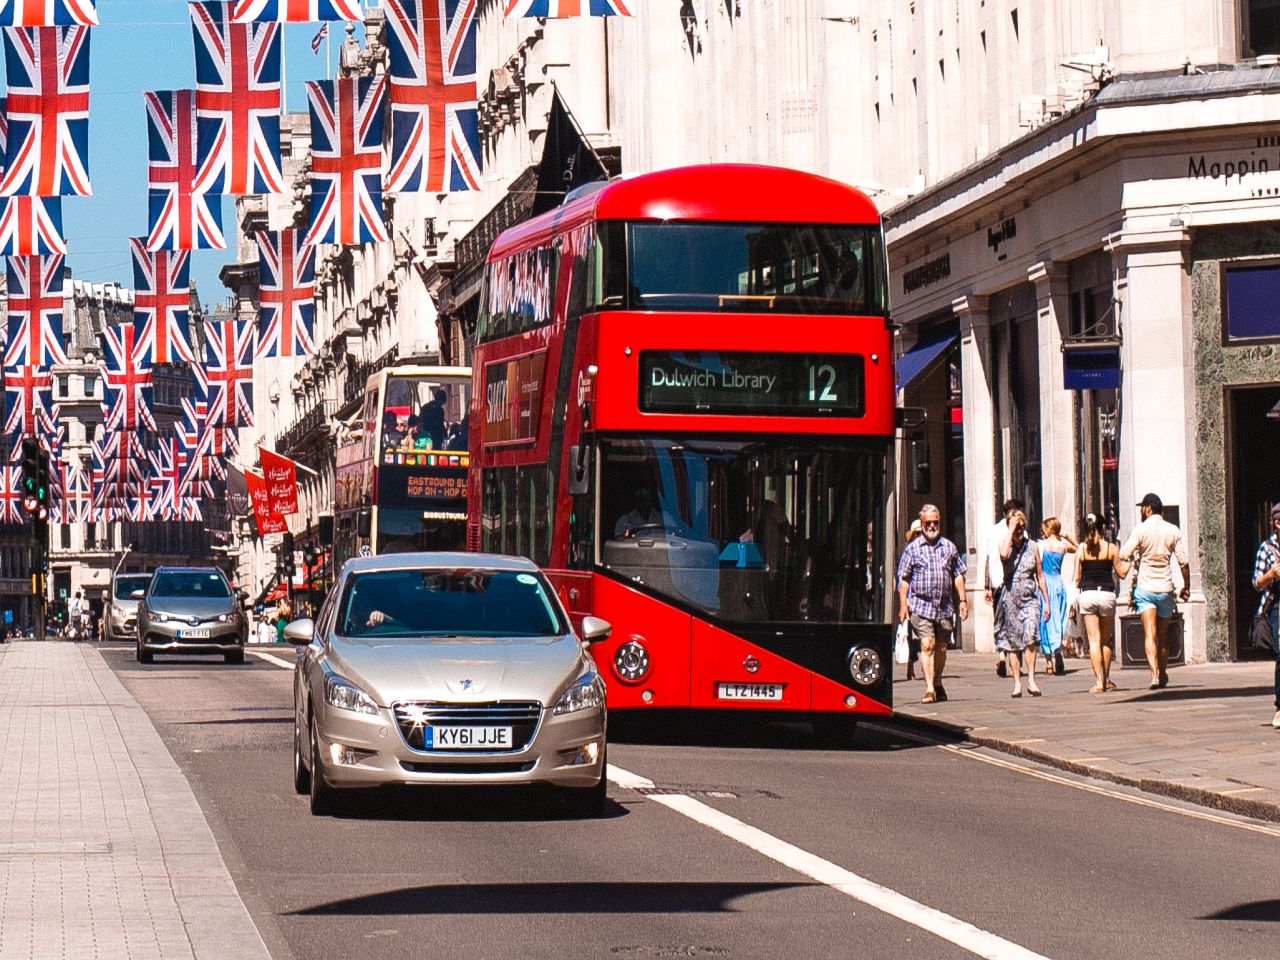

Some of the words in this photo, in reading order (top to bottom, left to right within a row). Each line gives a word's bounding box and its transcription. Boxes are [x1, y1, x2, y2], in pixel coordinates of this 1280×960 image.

[1188, 151, 1268, 187] Mappin
[652, 367, 716, 387] Dulwich
[722, 369, 777, 394] Library
[808, 364, 838, 401] 12
[408, 476, 455, 487] EASTBOUND
[407, 486, 422, 495] HOP
[424, 487, 436, 496] ON
[444, 488, 460, 497] HOP
[439, 728, 473, 745] KY61
[477, 728, 507, 744] JJE
